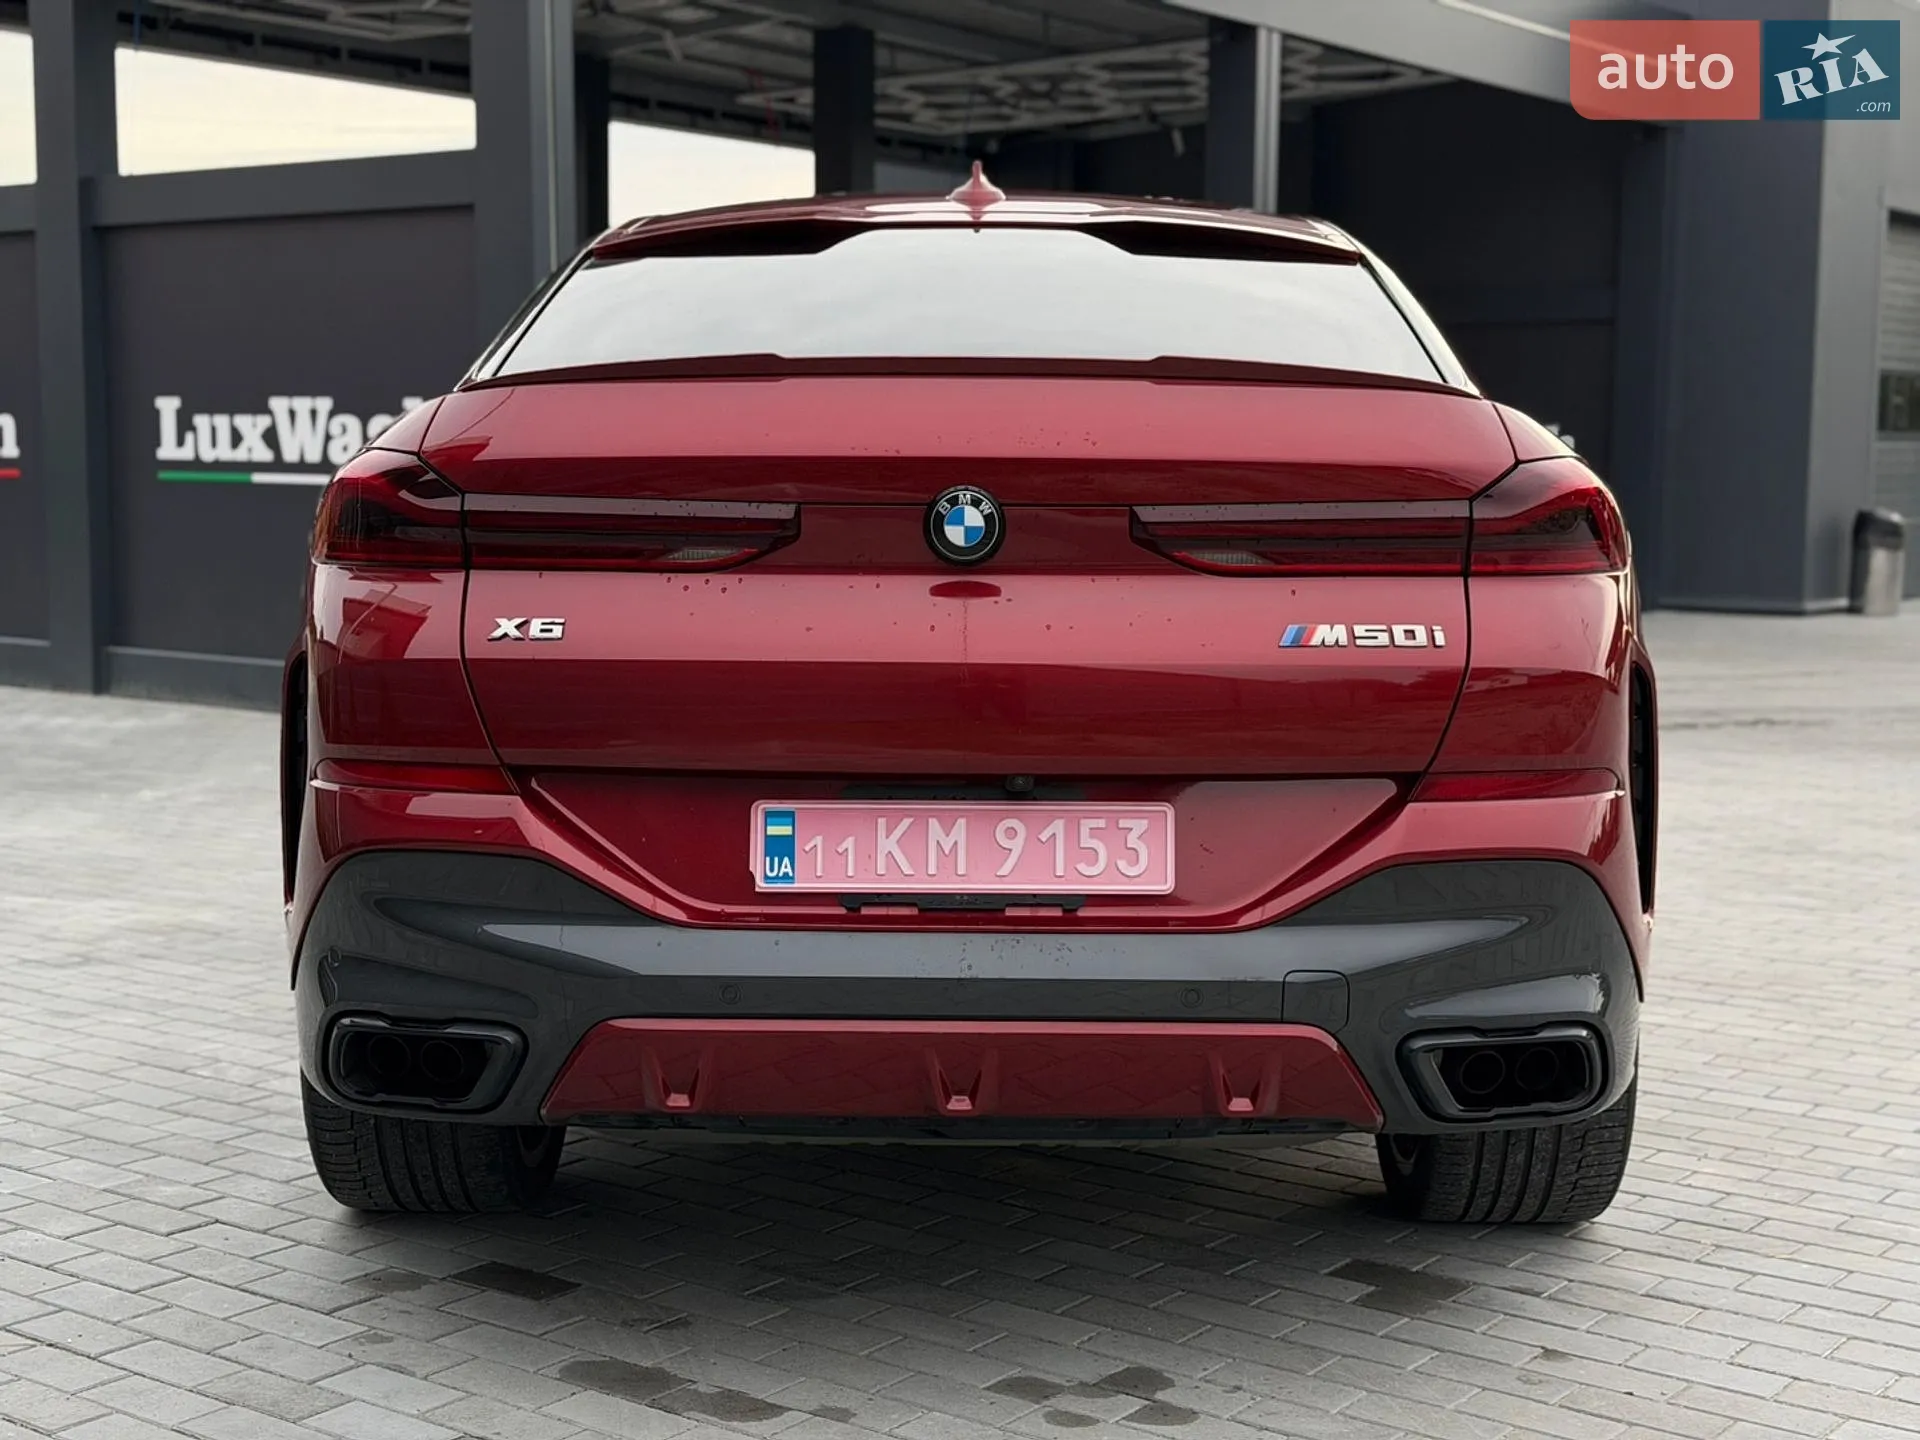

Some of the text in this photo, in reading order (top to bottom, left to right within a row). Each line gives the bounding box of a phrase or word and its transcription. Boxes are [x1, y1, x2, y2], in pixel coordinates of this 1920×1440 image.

[154, 396, 423, 465] LuxWa
[938, 494, 992, 516] BMW
[487, 618, 566, 641] X6
[875, 817, 967, 876] KM
[994, 817, 1149, 878] 9153
[765, 856, 793, 877] UA
